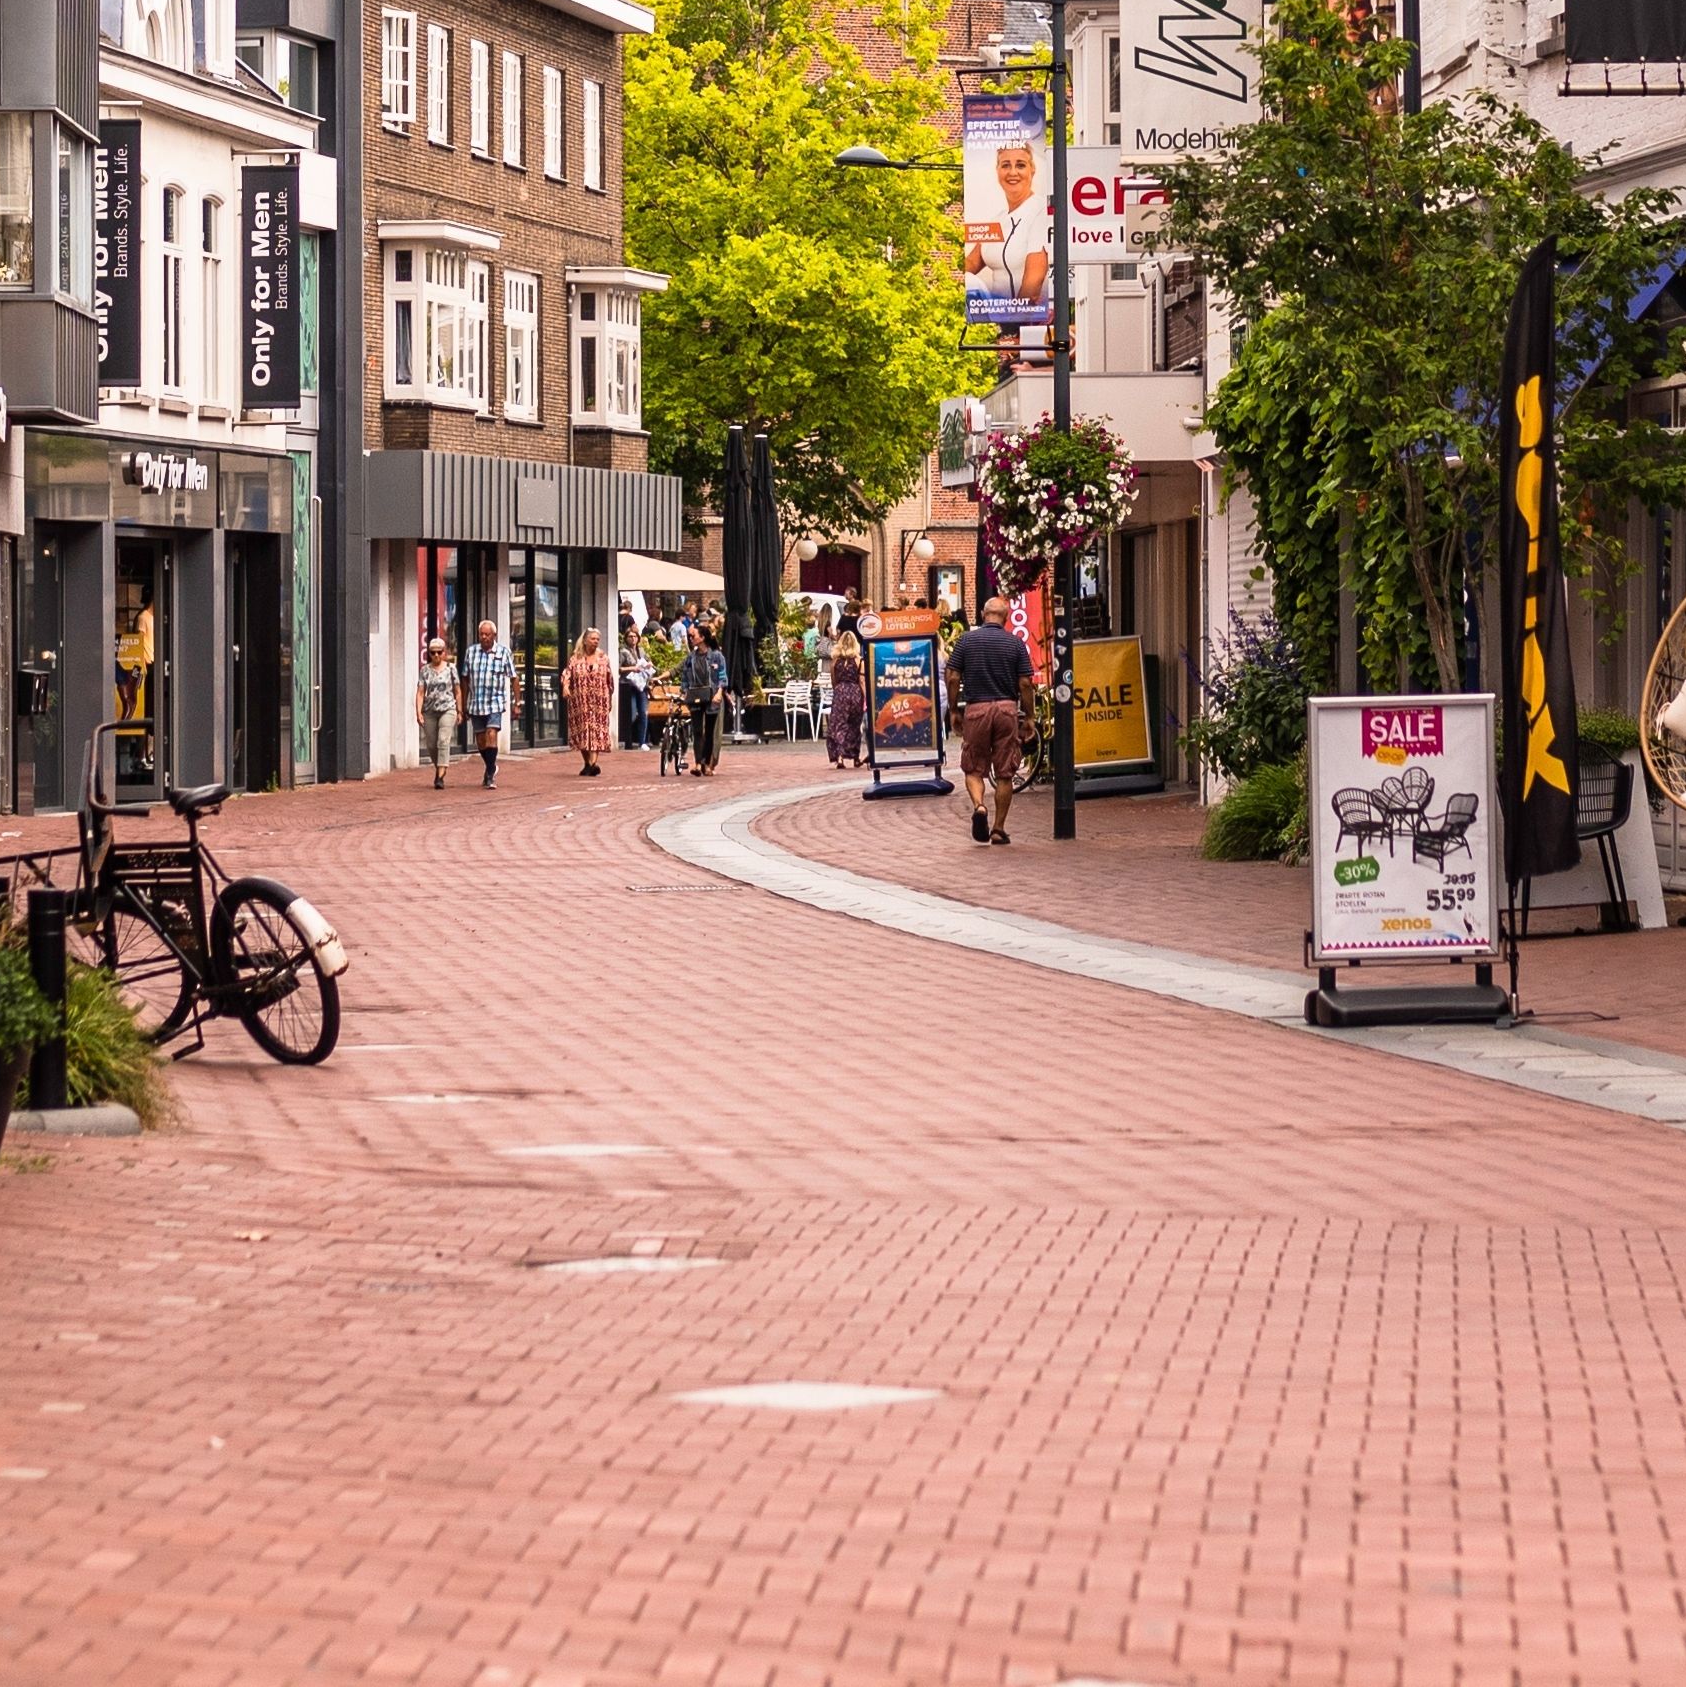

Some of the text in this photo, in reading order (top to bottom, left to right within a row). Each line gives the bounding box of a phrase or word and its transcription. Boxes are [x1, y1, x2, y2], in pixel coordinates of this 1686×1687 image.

[967, 120, 1020, 130] EFFECTIEF
[967, 130, 1031, 140] AFVALLEN IS
[114, 143, 132, 279] Brands. Style. Life.
[969, 226, 990, 234] SHOP
[1072, 227, 1112, 243] love
[275, 187, 291, 310] Brands. Style. Life.
[251, 191, 275, 387] Only for Men
[970, 298, 1030, 307] OOSTERHOUT
[142, 452, 168, 496] Only
[185, 456, 208, 490] Men
[885, 614, 933, 623] NEDERLANDSE
[885, 622, 915, 631] LOTERIJ
[885, 664, 921, 677] Mega
[877, 676, 930, 690] Jackpot
[1074, 684, 1133, 710] SALE
[1085, 709, 1123, 723] INSIDE
[1370, 714, 1436, 743] SALE
[1339, 863, 1376, 880] -30%
[1426, 888, 1475, 911] 55.99
[1381, 917, 1432, 931] xenos
